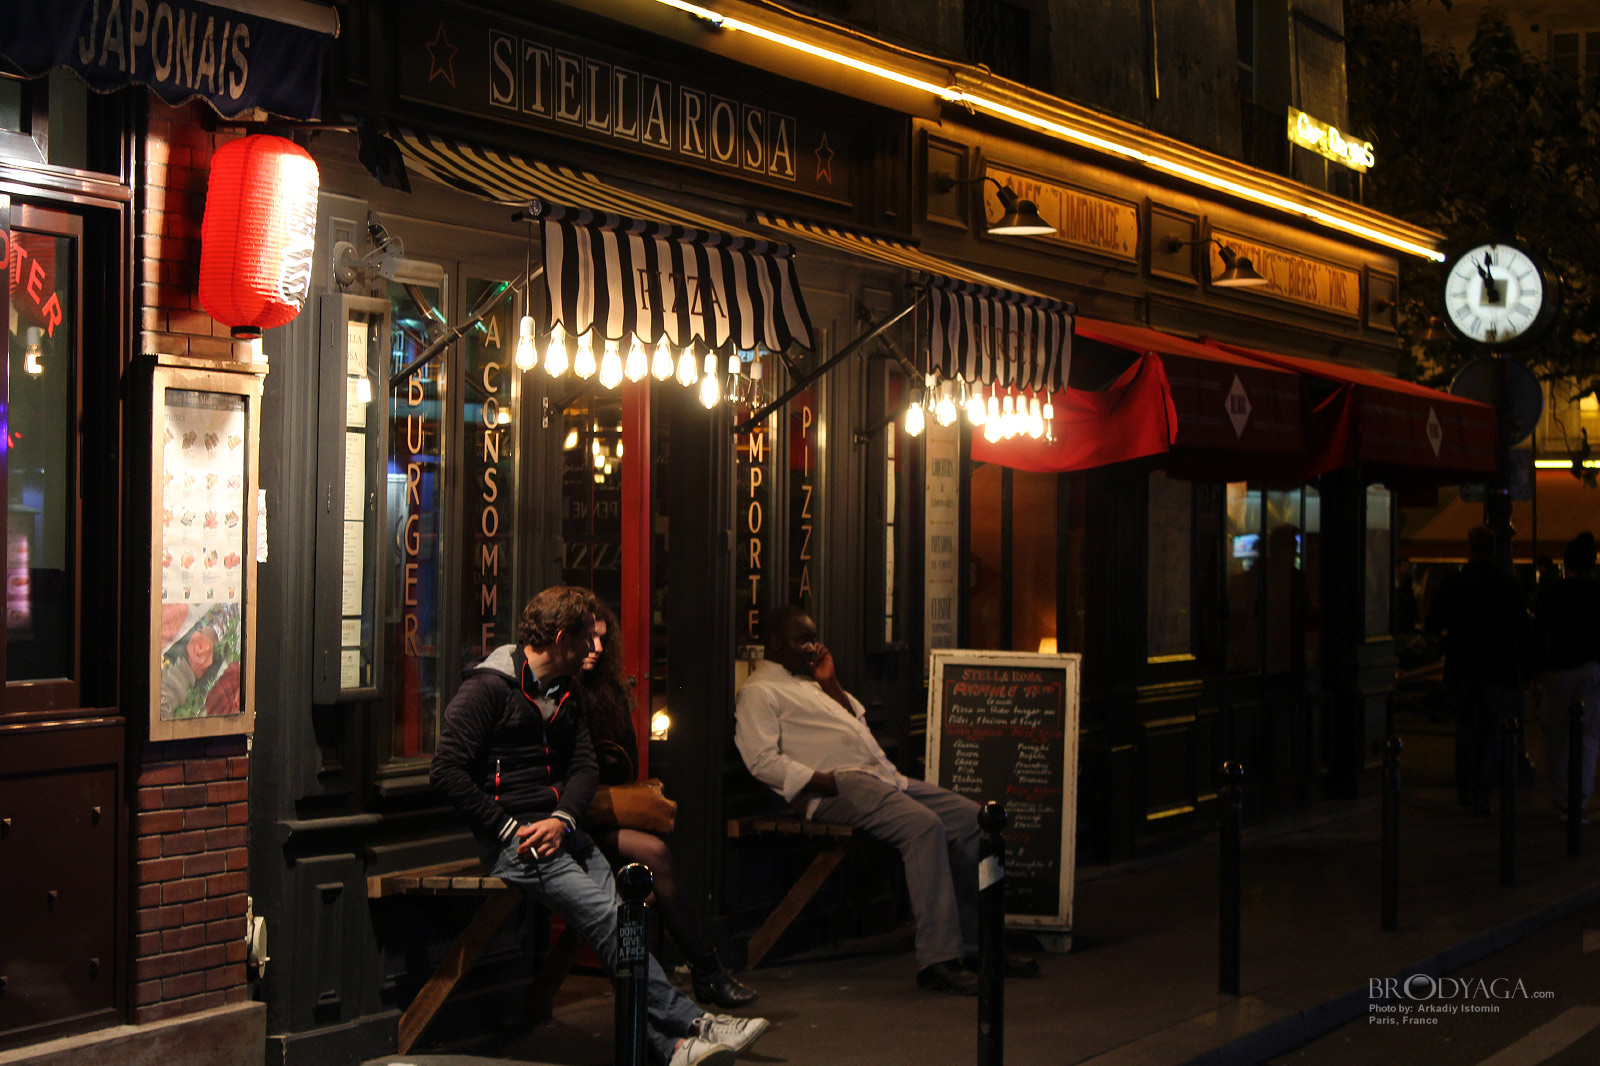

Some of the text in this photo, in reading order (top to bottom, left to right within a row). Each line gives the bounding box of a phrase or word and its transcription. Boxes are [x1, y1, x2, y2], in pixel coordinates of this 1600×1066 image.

[79, 0, 250, 100] JAPONAIS
[492, 36, 795, 176] STELLA ROSA
[403, 366, 425, 658] BURGER
[800, 405, 814, 599] PIZZA
[962, 668, 1009, 683] STELLA
